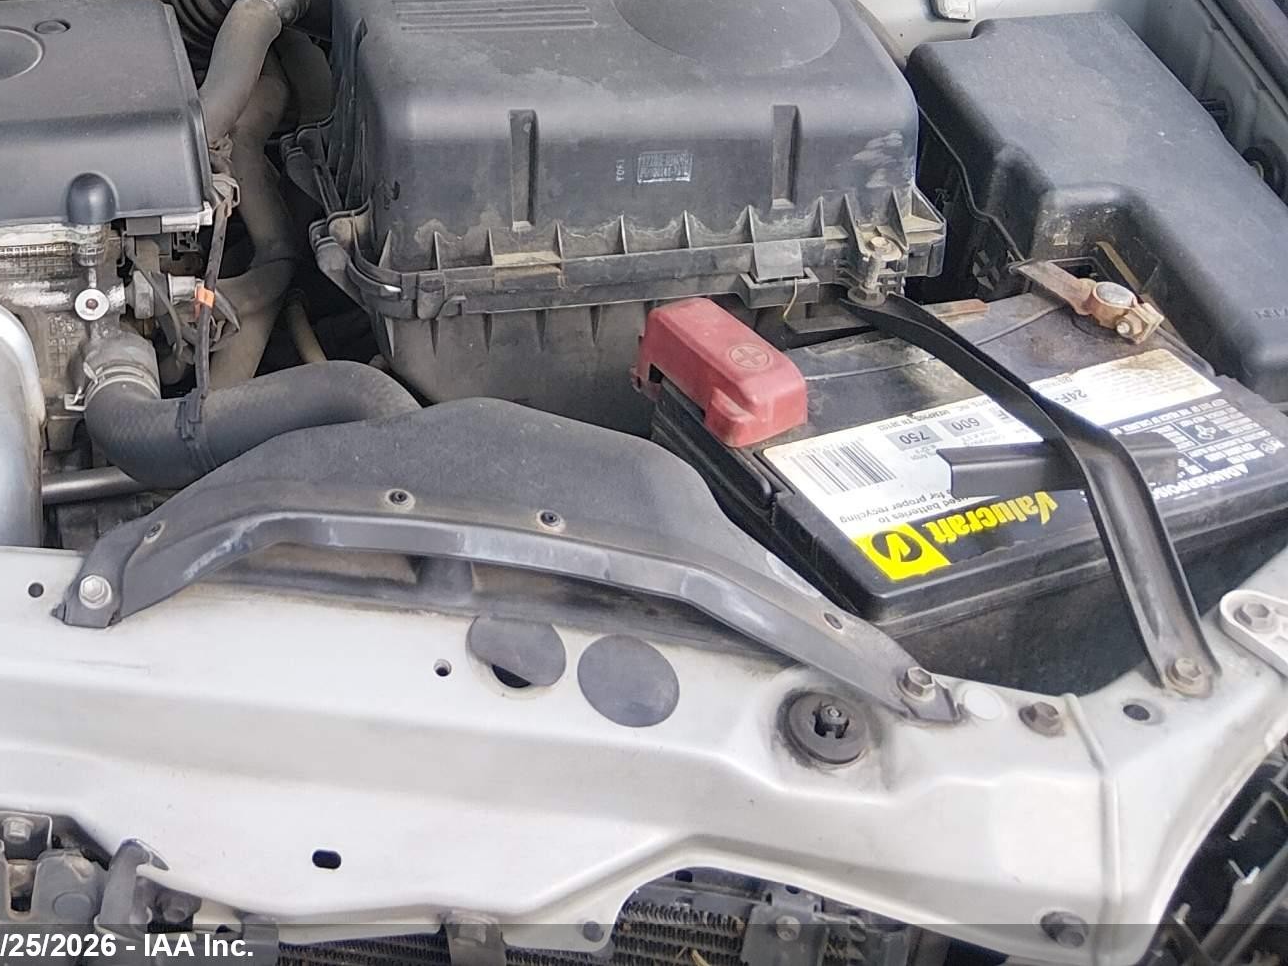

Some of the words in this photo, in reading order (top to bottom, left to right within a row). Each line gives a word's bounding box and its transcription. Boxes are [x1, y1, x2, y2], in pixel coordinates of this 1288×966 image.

[952, 418, 980, 431] 600
[899, 431, 929, 445] 750
[892, 494, 926, 510] proper
[840, 505, 890, 524] recycling
[892, 502, 940, 520] batteries
[925, 491, 1058, 545] Valucraft
